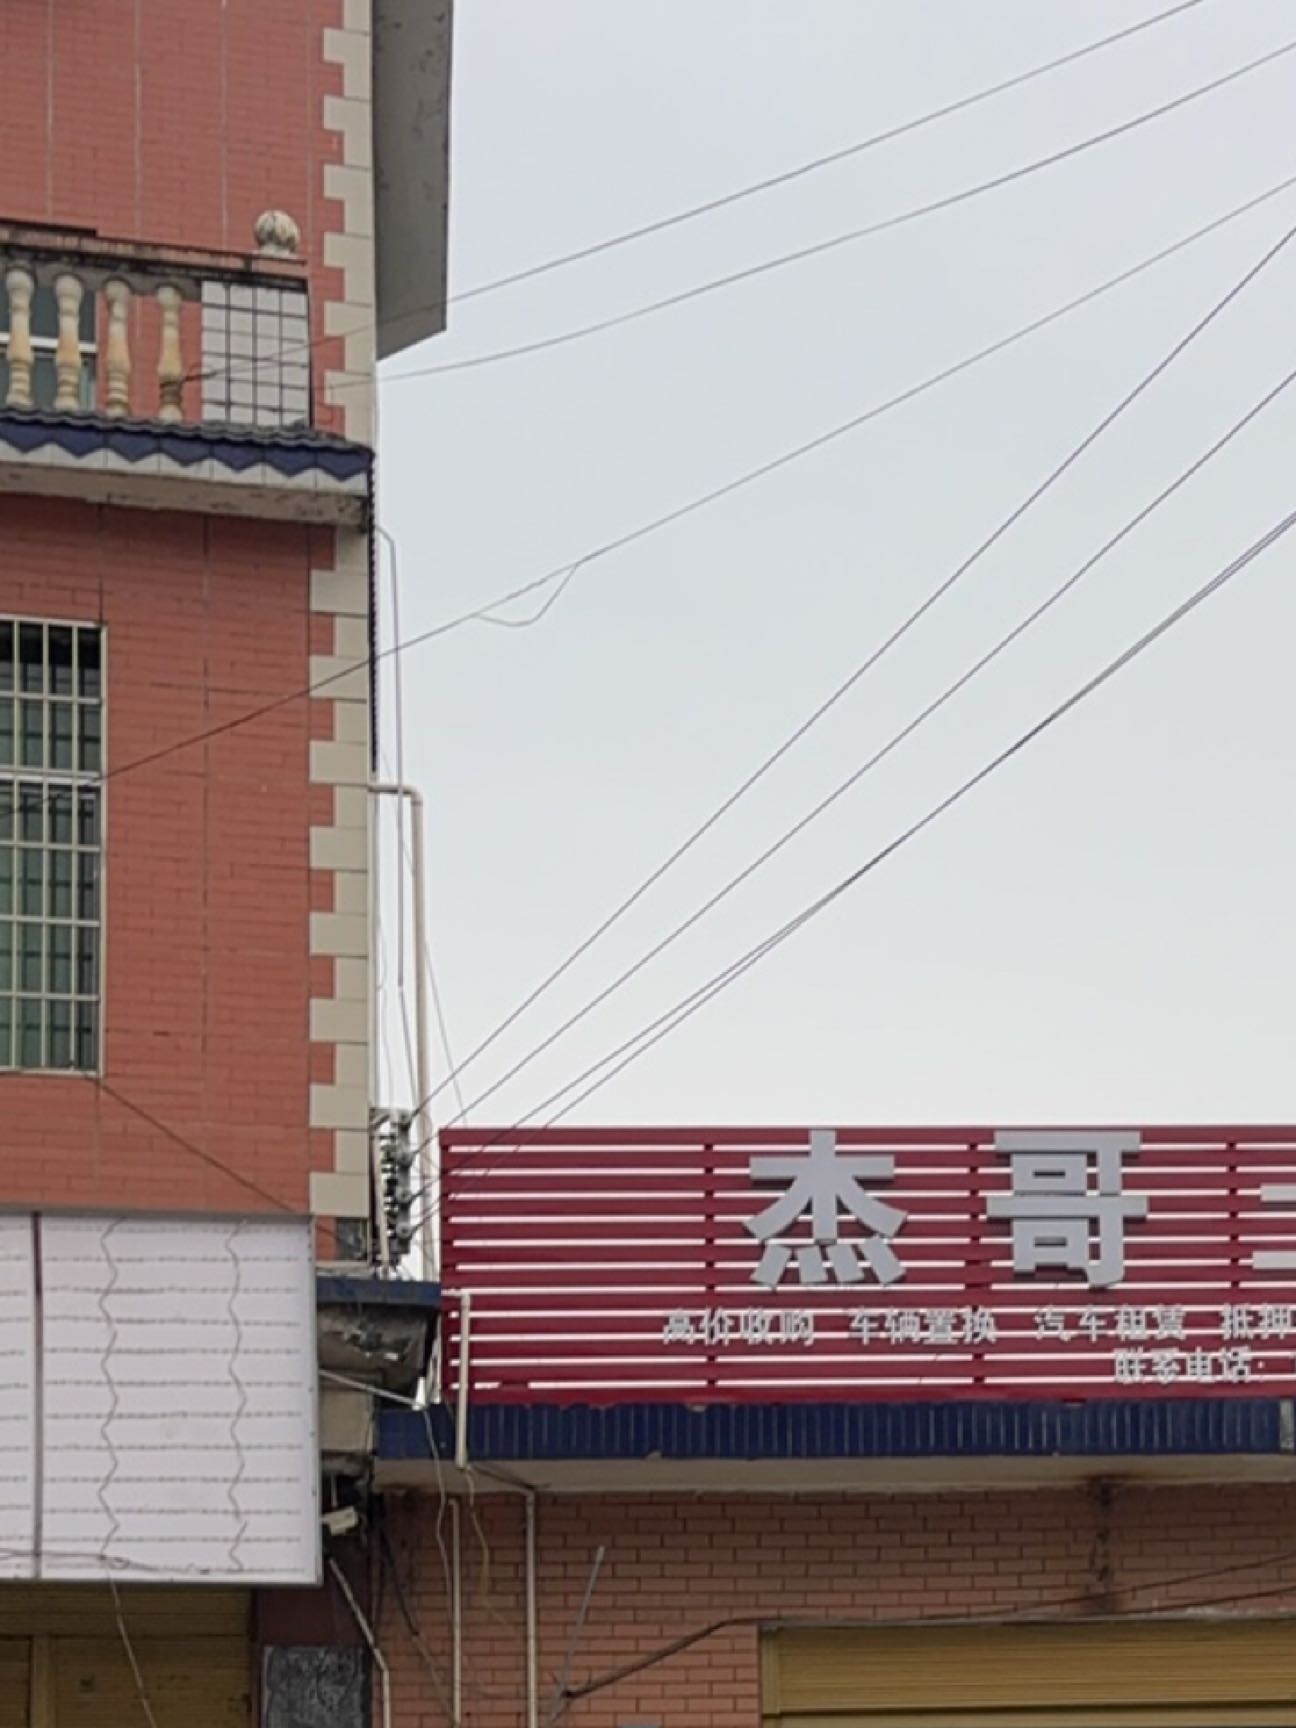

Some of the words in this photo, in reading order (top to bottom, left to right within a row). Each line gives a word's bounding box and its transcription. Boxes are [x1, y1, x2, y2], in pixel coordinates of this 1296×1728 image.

[663, 1306, 815, 1346] 高价收购
[849, 1305, 998, 1345] 车辆置换
[1034, 1303, 1187, 1342] 汽车租赁
